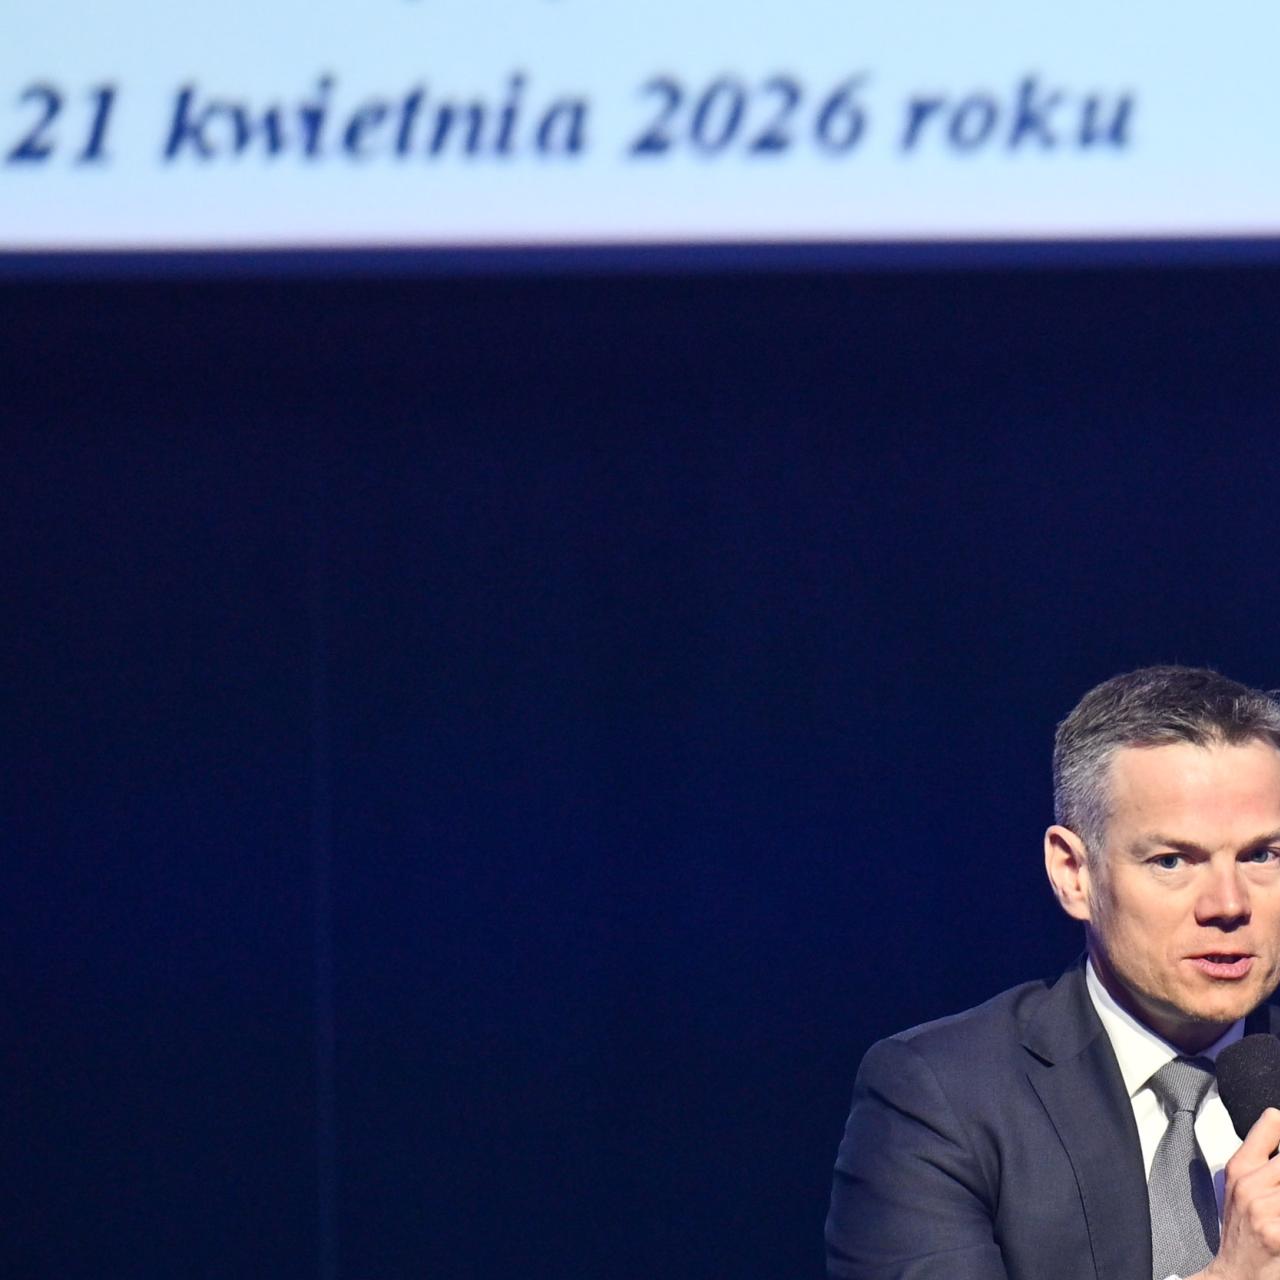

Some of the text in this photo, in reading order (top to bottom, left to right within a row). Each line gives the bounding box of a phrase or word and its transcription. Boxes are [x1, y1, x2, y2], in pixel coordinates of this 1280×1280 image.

[5, 74, 1134, 167] 21 kwietnia 2026 roku
